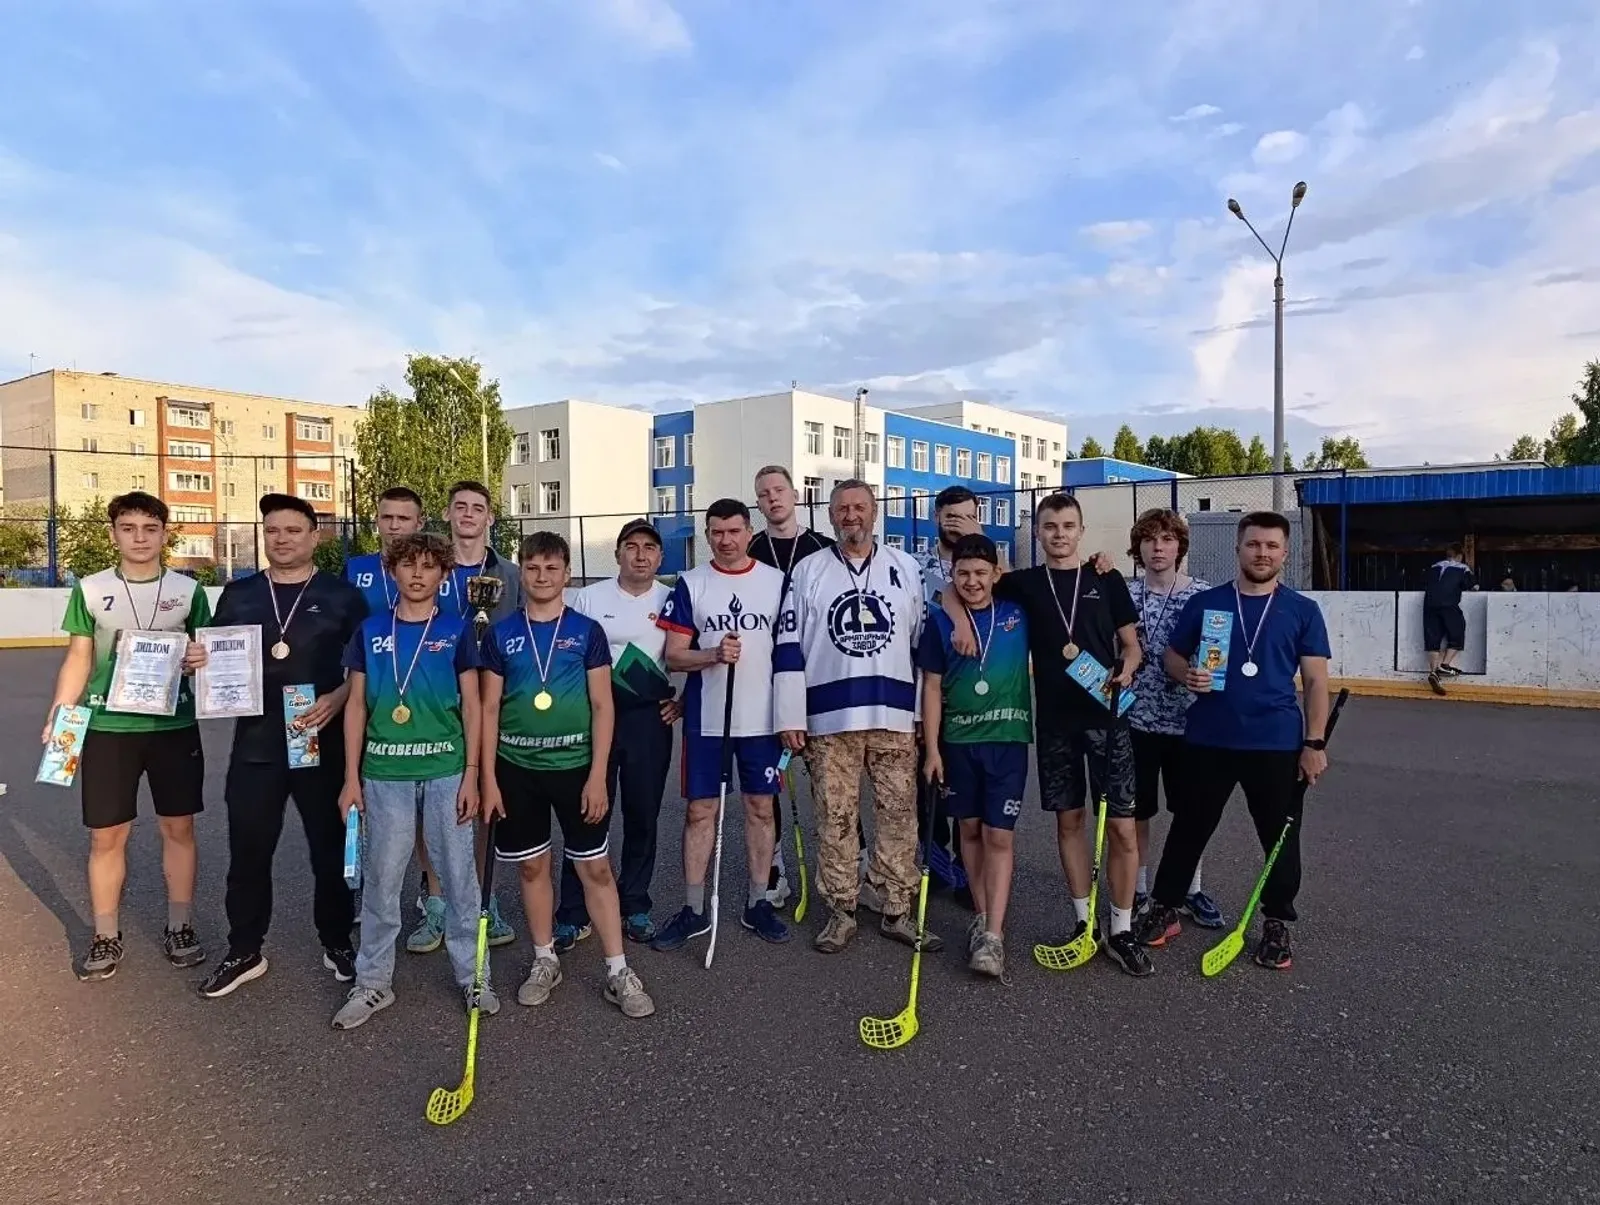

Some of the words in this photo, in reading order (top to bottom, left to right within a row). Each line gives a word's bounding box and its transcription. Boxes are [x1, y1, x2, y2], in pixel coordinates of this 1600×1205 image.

[356, 572, 373, 588] 19
[102, 595, 115, 611] 7
[703, 612, 772, 633] ARION
[133, 641, 170, 655] ДИПЛОМ
[211, 639, 245, 654] ДИПЛОМ
[371, 635, 394, 654] 24
[506, 636, 525, 655] 27
[851, 640, 877, 652] ЗАВОД
